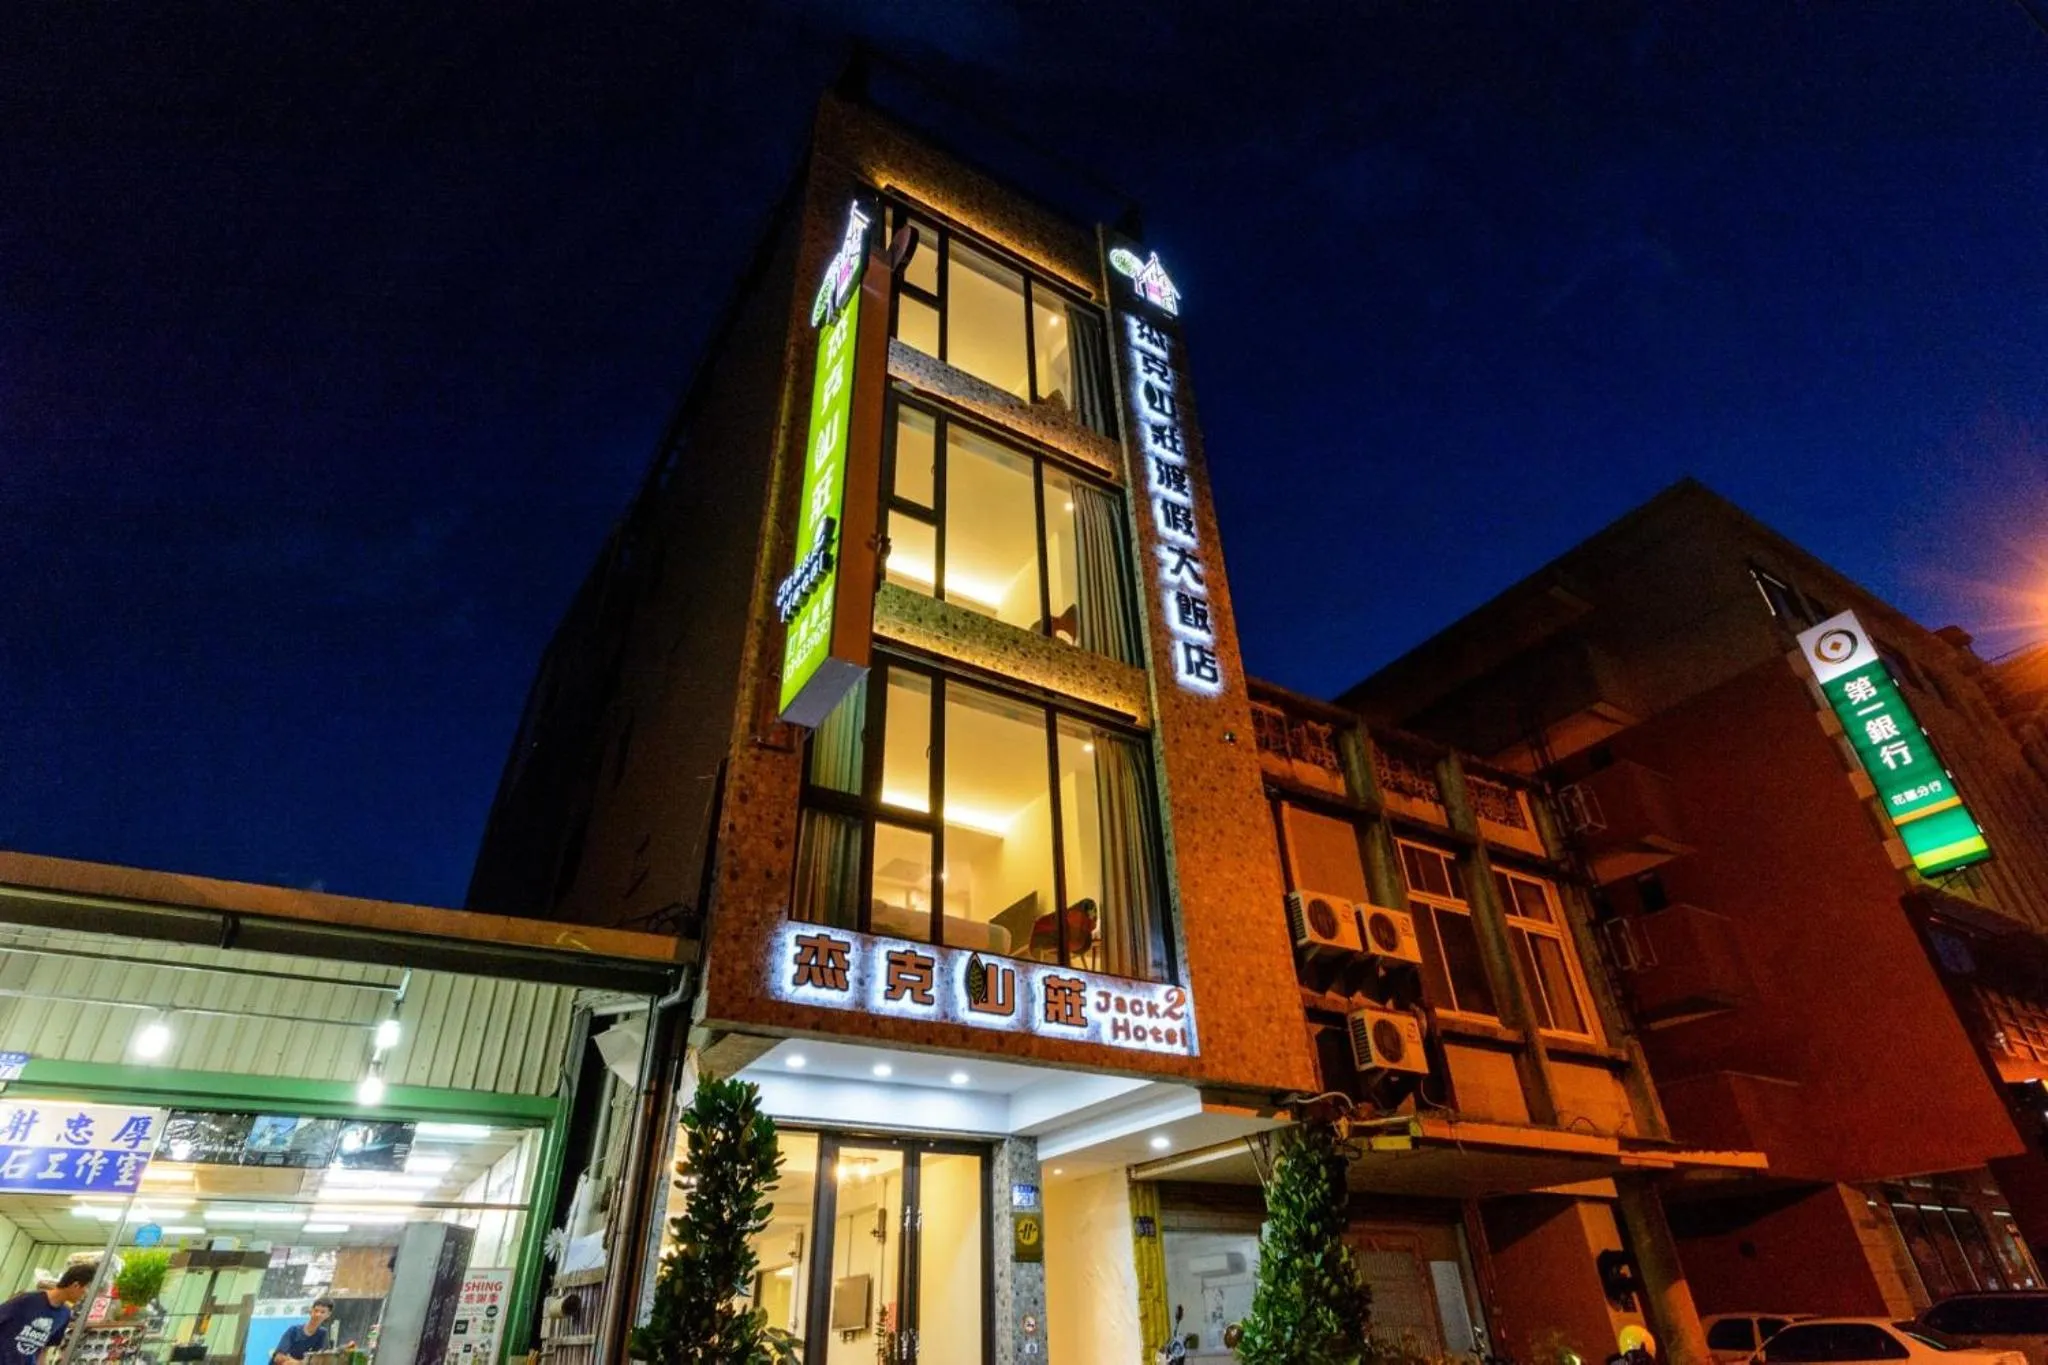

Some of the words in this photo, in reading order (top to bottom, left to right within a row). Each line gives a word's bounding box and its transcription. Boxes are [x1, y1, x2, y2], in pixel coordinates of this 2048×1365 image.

[1844, 675, 1913, 770] 第一銀行
[793, 934, 1087, 1027] 杰克山莊
[1112, 1017, 1188, 1048] Hotel
